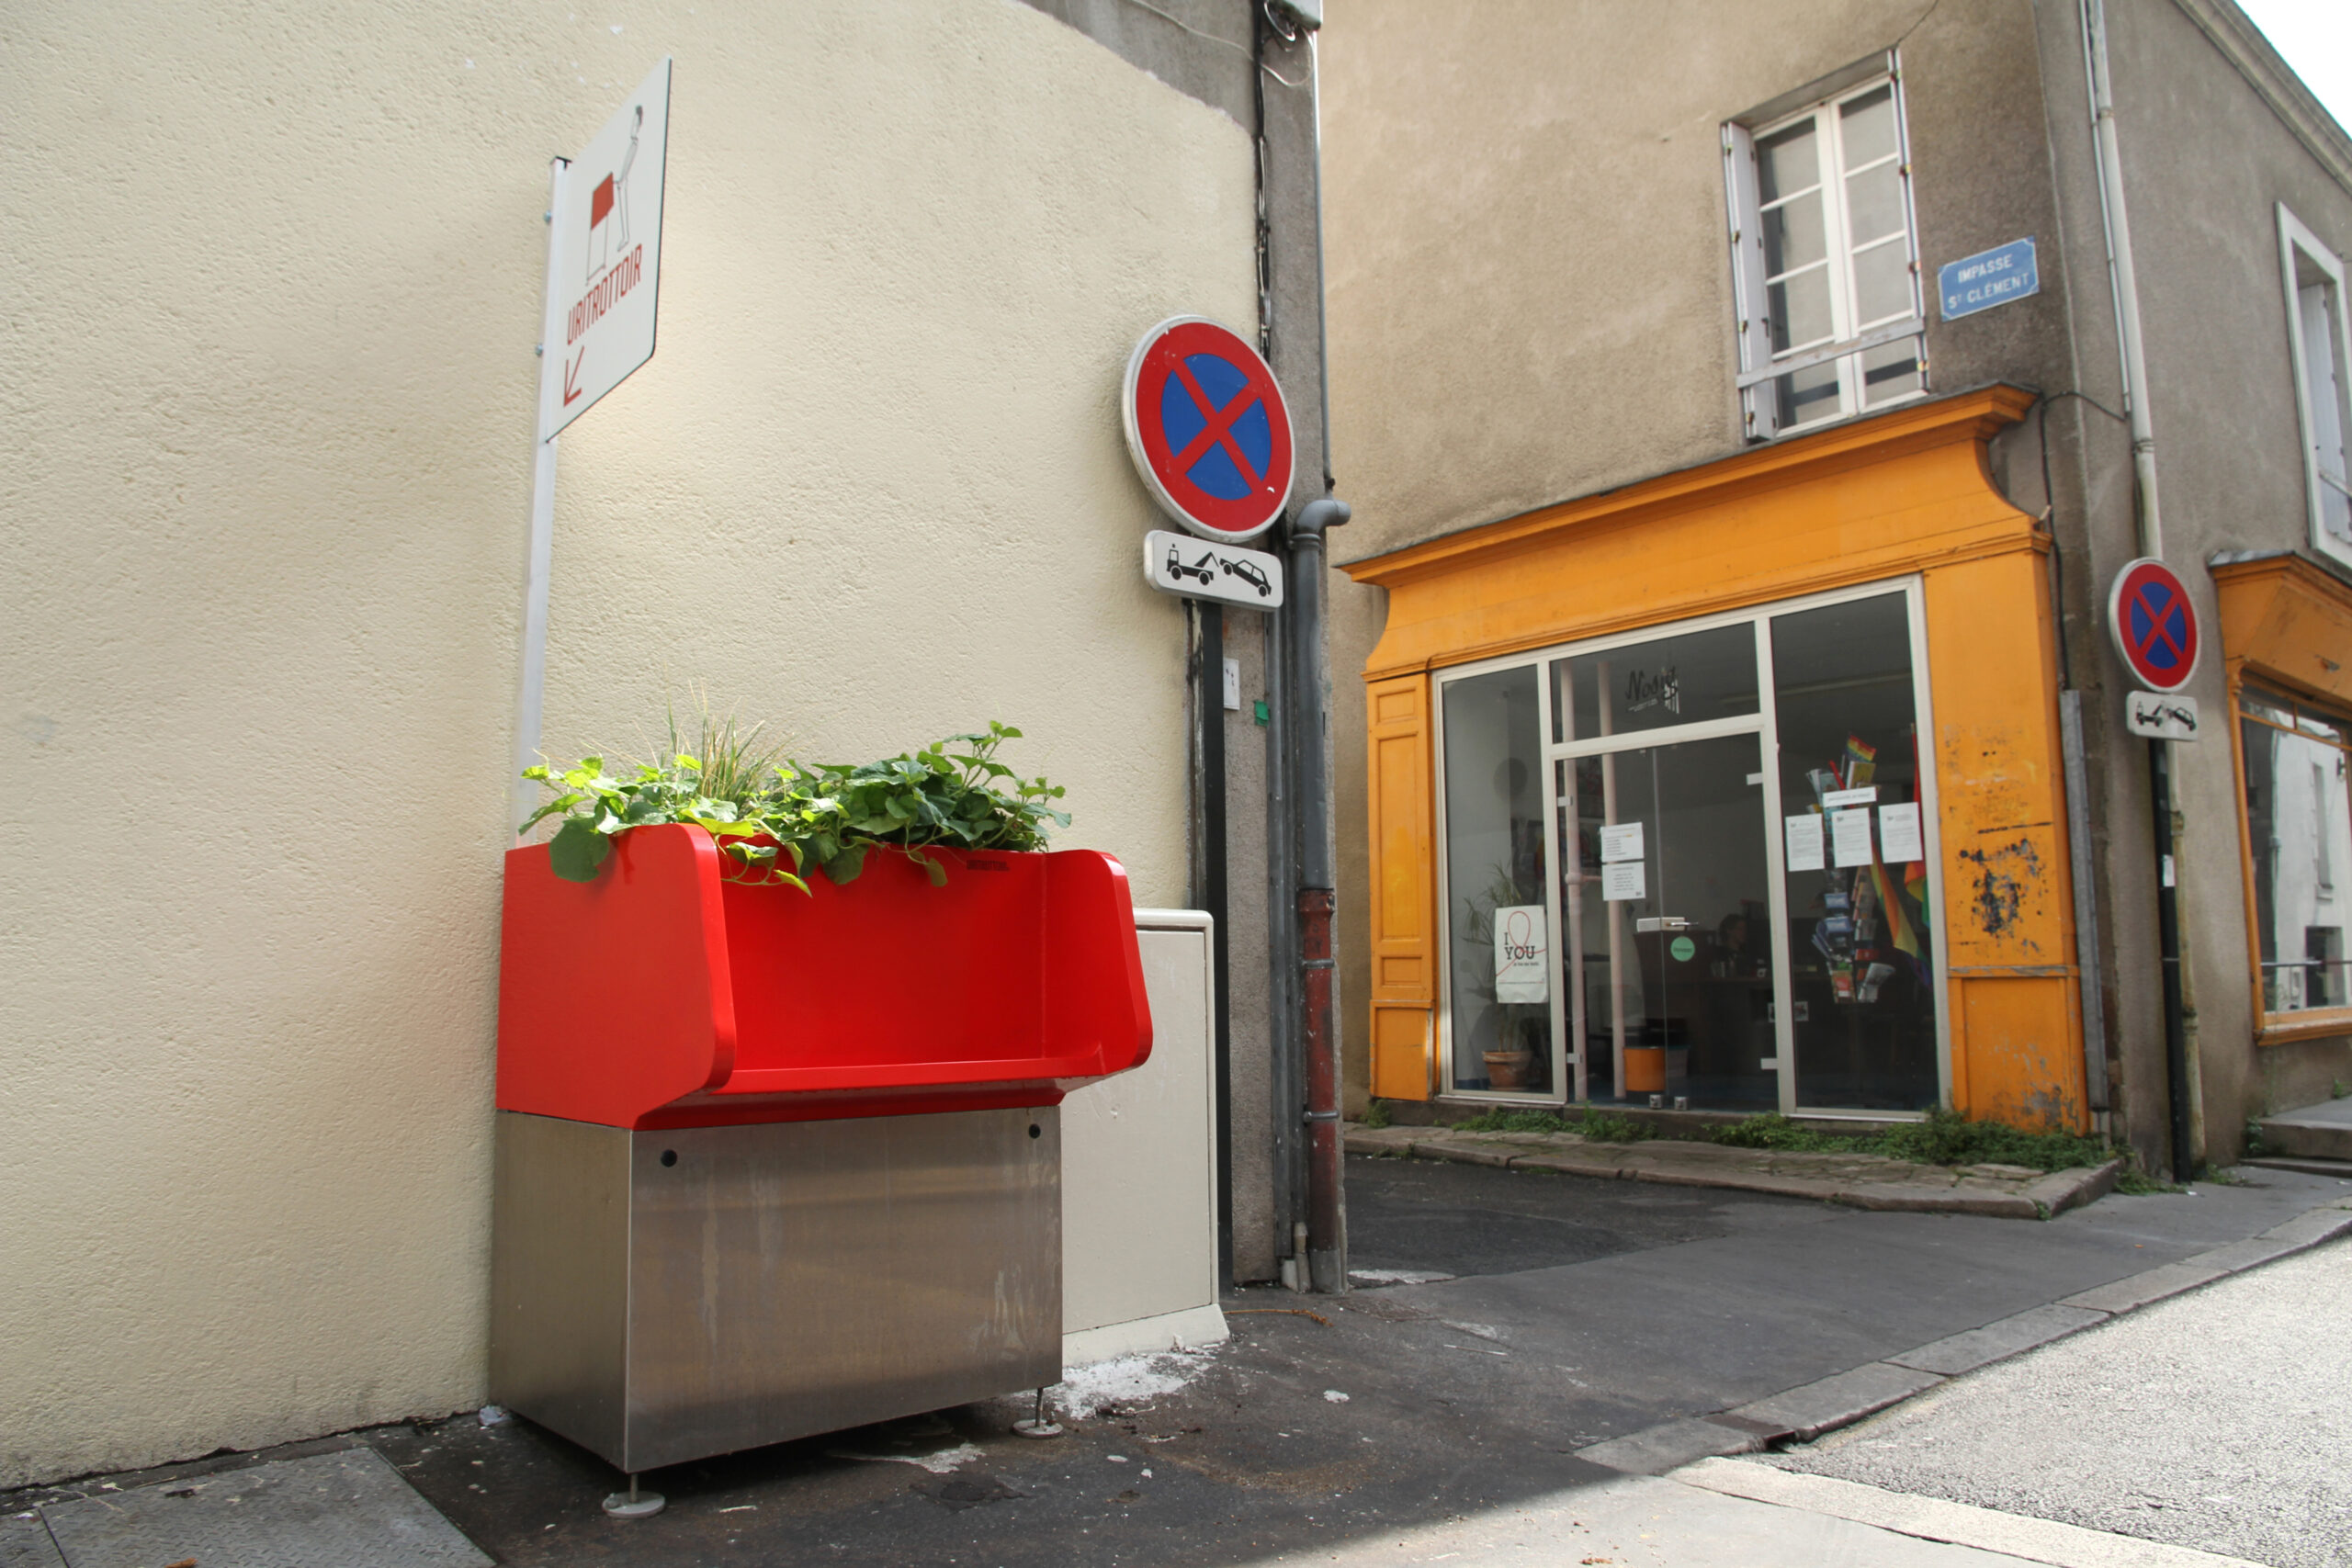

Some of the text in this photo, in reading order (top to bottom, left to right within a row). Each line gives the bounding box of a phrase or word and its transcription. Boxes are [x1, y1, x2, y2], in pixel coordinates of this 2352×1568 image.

[1958, 254, 2013, 283] IMPASSE
[567, 243, 642, 345] URITROTTOIR
[1504, 945, 1535, 960] YOU
